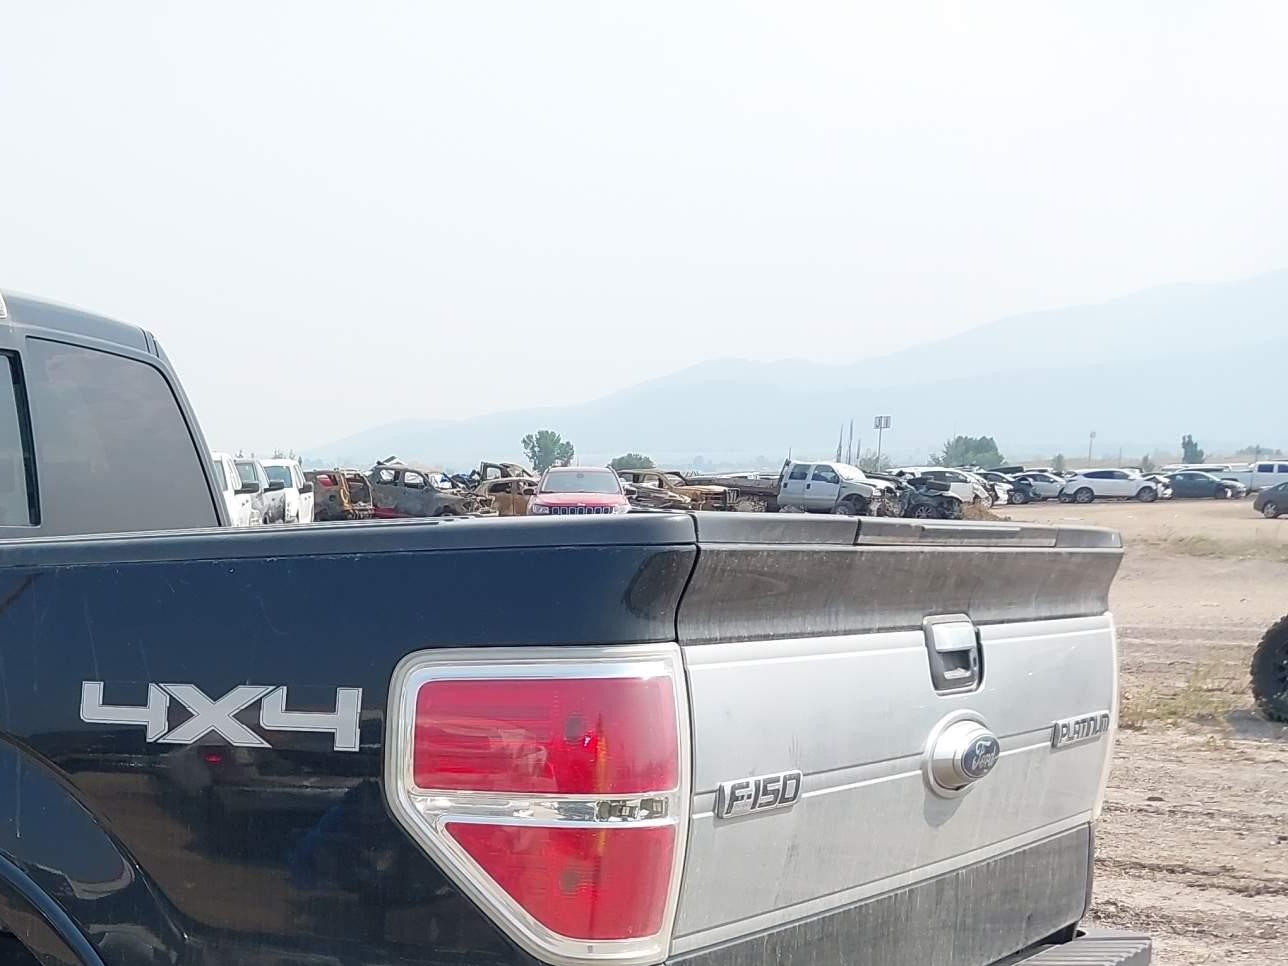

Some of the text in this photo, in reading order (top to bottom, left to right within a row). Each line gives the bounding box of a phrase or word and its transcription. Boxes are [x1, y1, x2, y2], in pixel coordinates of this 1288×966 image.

[1059, 713, 1109, 743] PLATINUM
[972, 741, 998, 770] Ford
[725, 773, 800, 815] F-150
